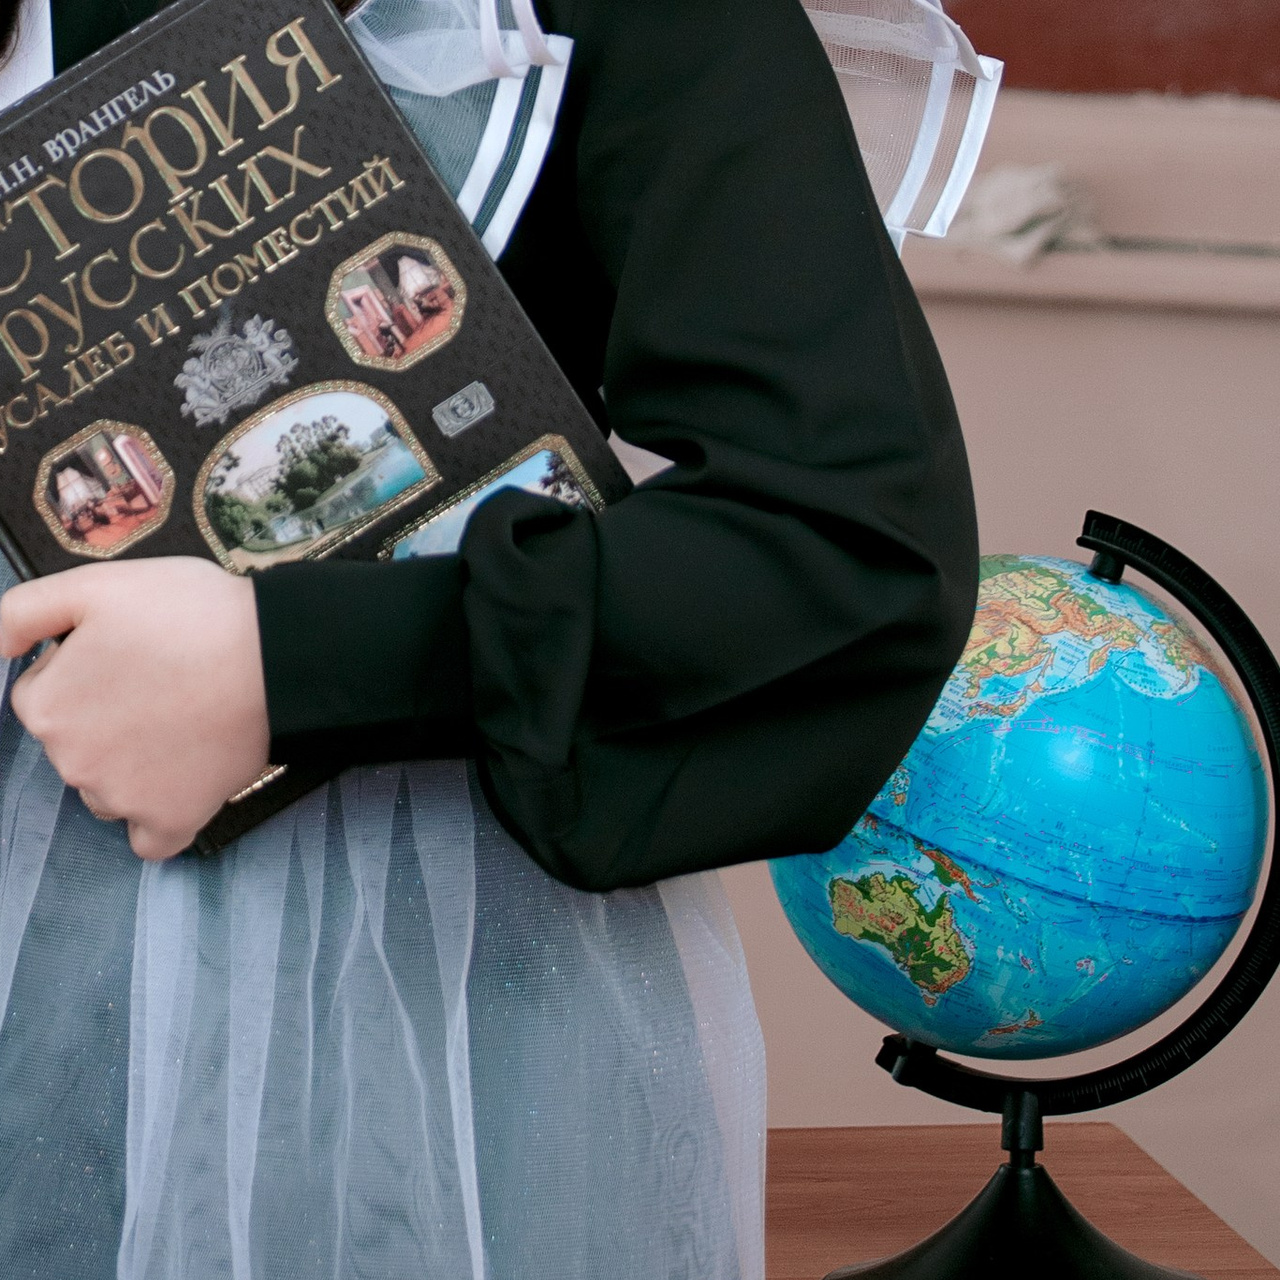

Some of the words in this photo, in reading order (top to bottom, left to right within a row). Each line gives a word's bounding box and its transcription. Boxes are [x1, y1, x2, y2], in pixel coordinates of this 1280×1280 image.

[45, 69, 176, 162] ВРАНГЕЛЬ
[135, 302, 182, 348] И
[178, 155, 406, 319] ПОМЕСТИЙ
